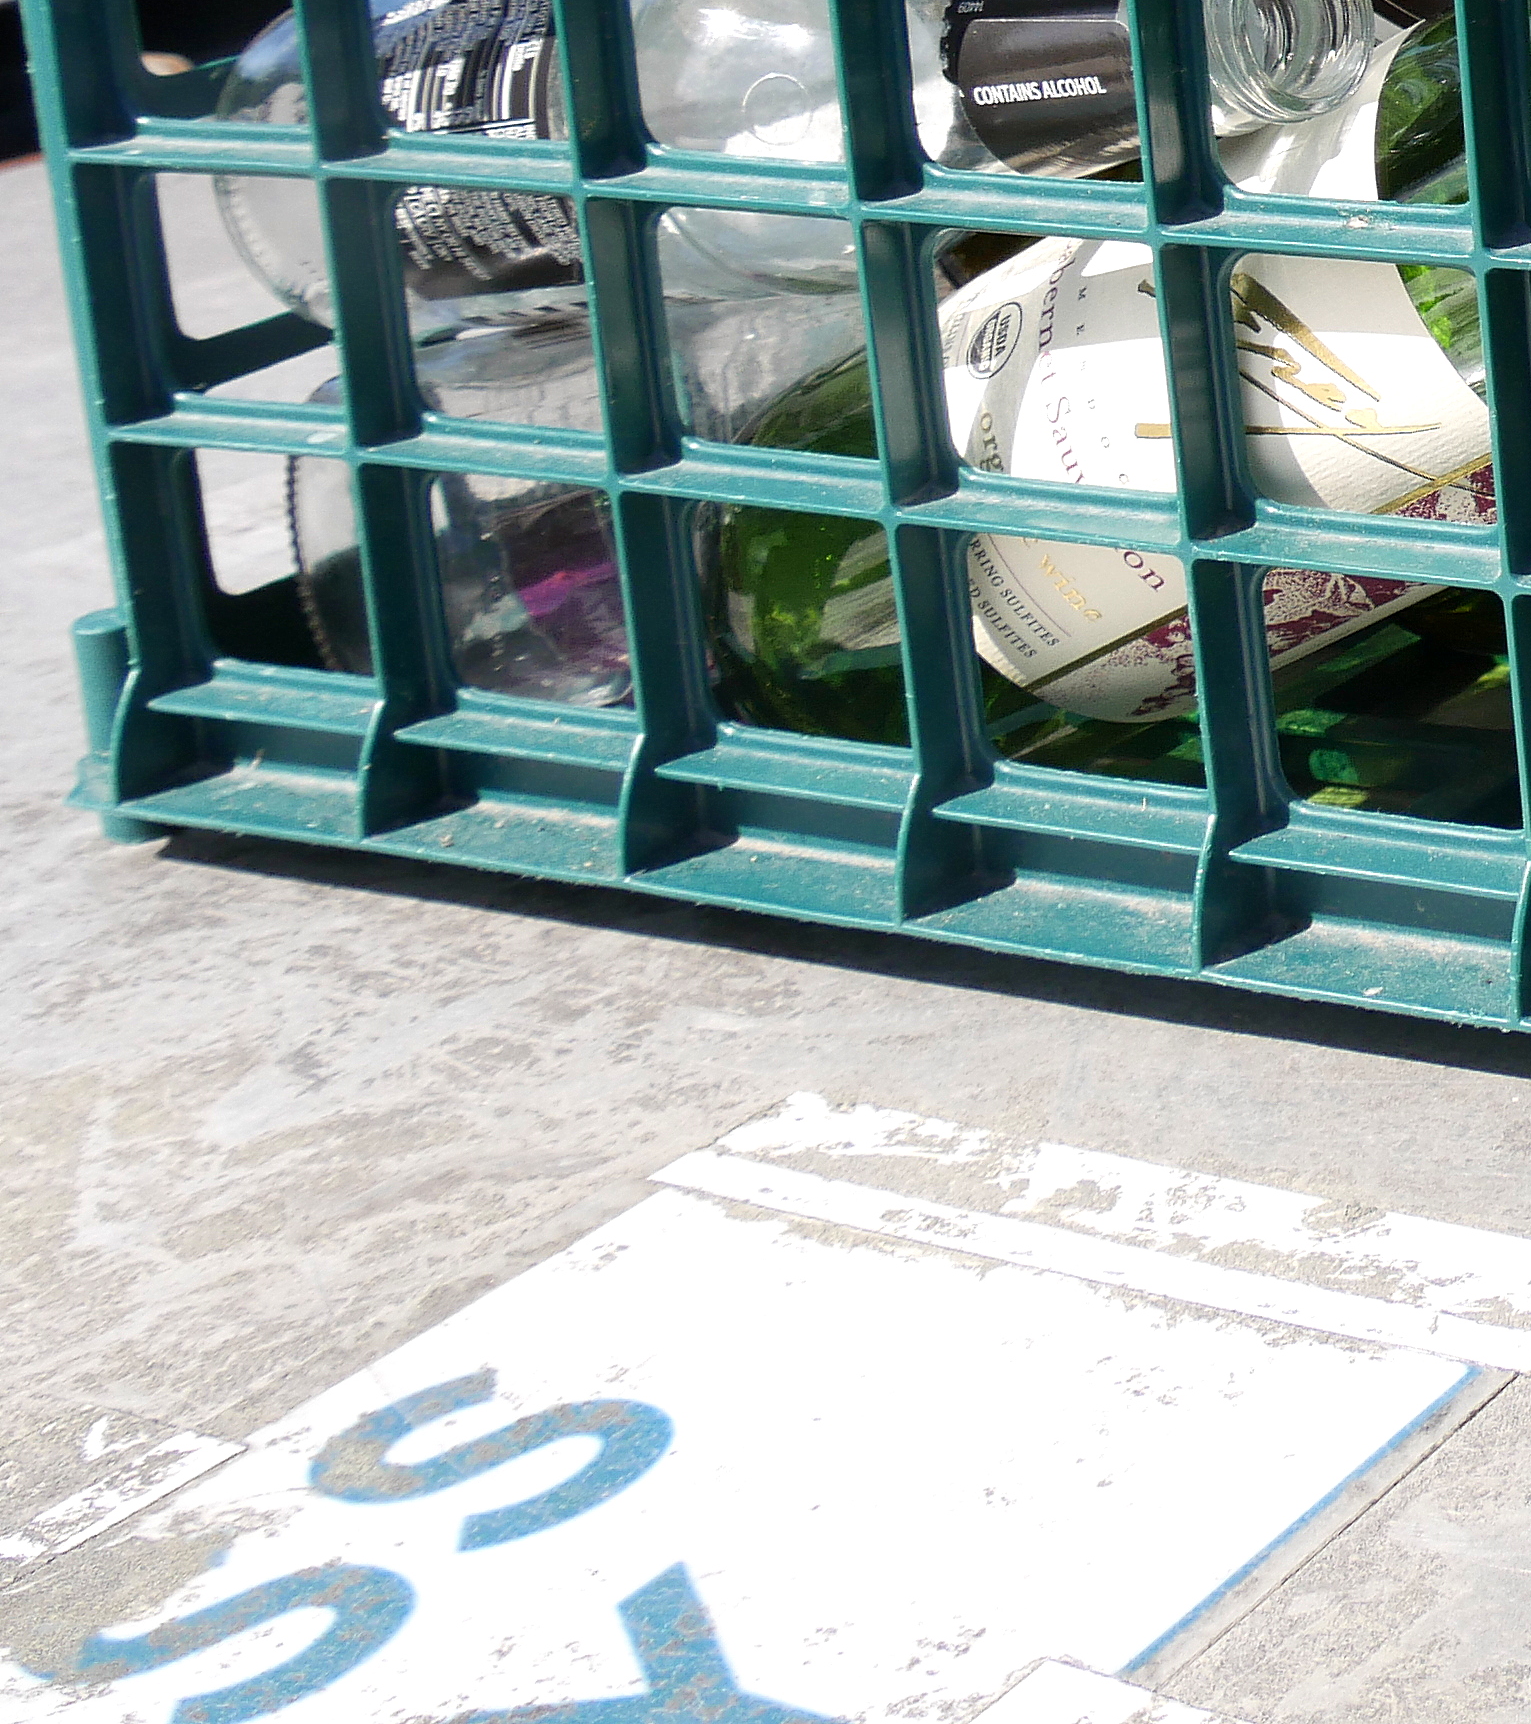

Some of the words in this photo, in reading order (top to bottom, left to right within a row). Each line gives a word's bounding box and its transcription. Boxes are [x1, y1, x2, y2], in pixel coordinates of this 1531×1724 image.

[973, 81, 1043, 106] CONTAINS
[1042, 76, 1107, 99] ALCOHOL
[994, 313, 1012, 358] USDA
[970, 539, 1004, 588] RRING
[1000, 587, 1061, 648] SULFITES
[1039, 554, 1102, 623] wine
[977, 599, 1038, 659] SULFITES
